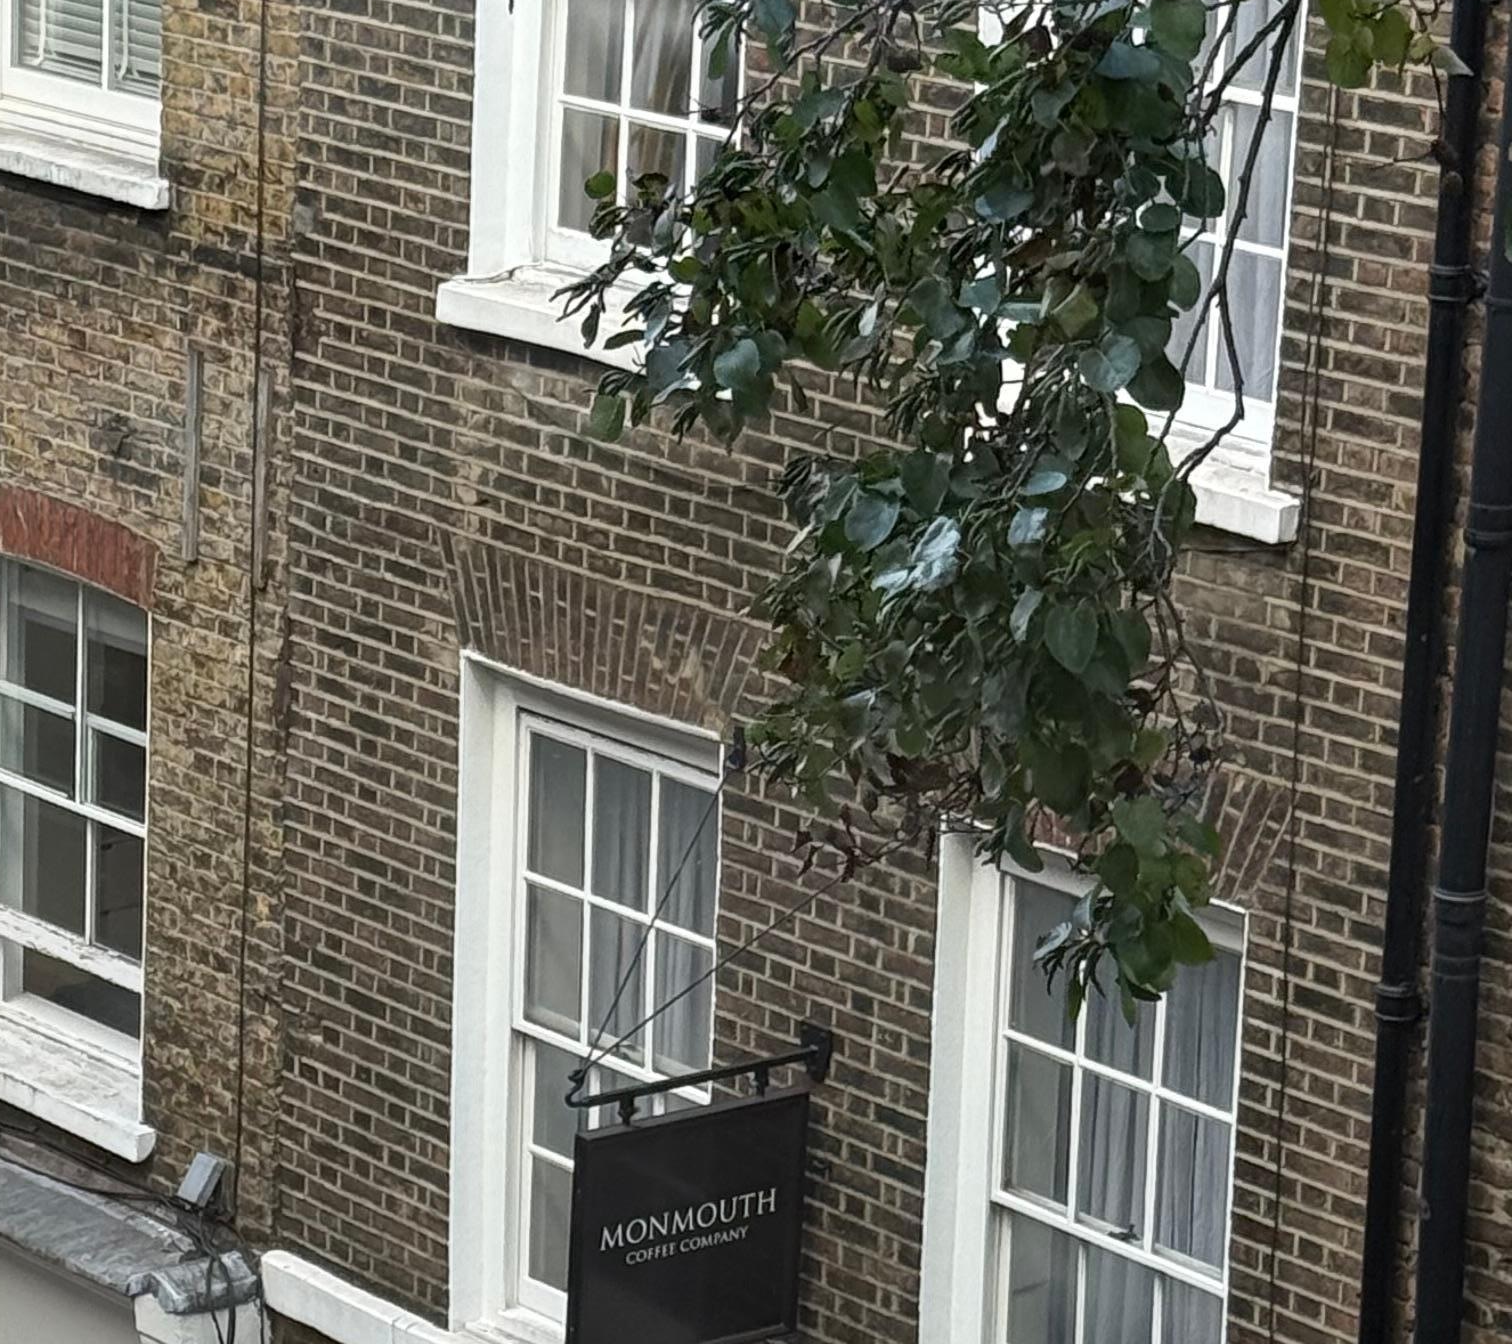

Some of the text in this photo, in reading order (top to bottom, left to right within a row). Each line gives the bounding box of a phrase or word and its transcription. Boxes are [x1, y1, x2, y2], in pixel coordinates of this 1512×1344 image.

[600, 1188, 777, 1251] MONMOUTH
[626, 1226, 749, 1265] COFFEE COMPANY
